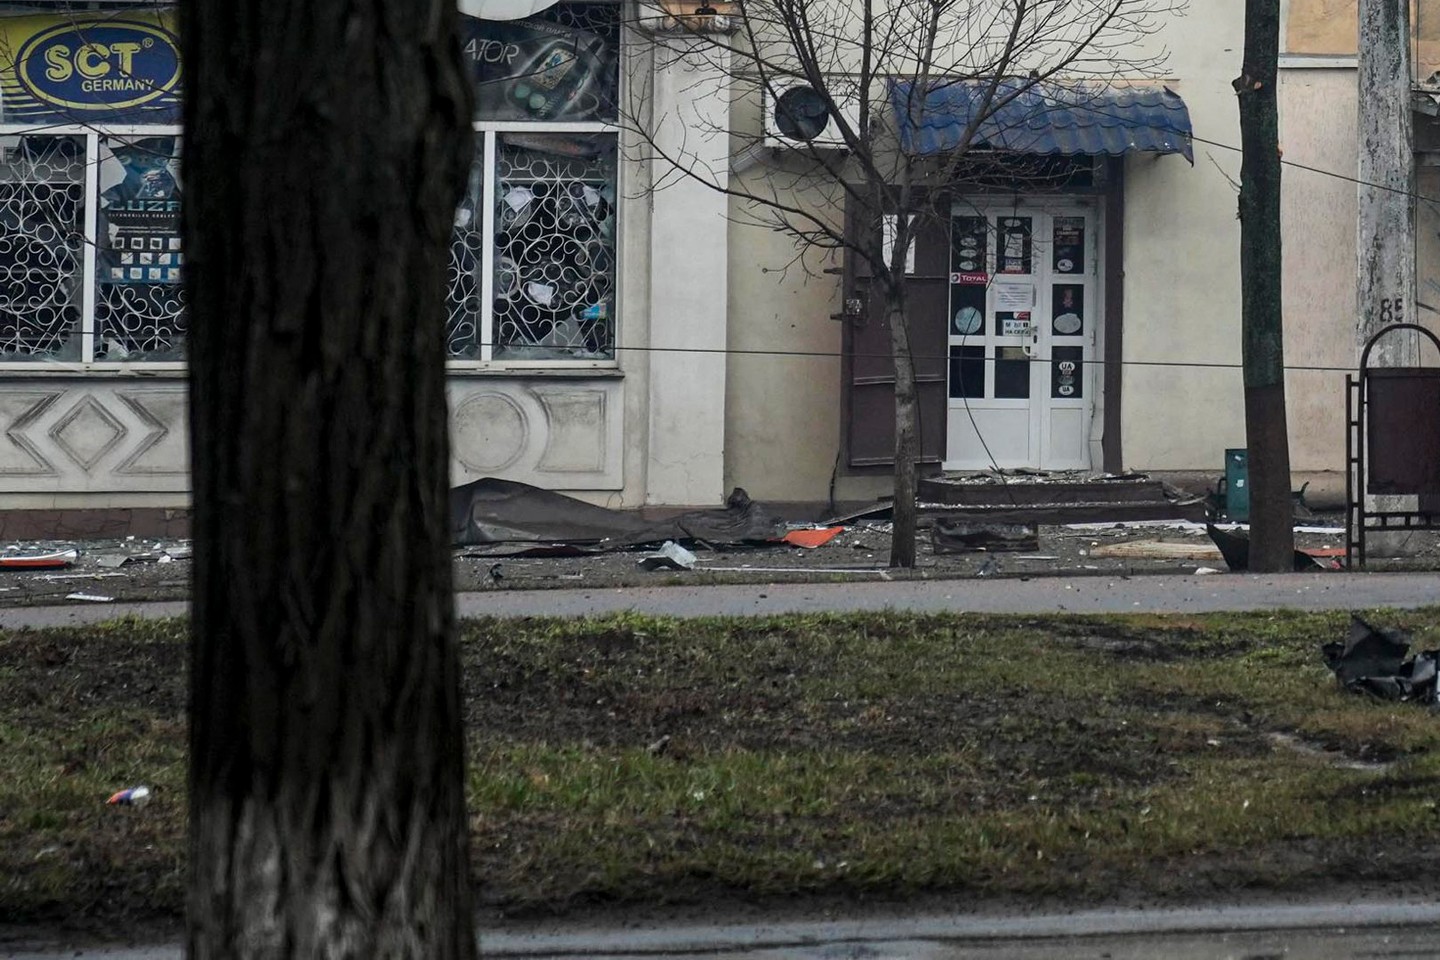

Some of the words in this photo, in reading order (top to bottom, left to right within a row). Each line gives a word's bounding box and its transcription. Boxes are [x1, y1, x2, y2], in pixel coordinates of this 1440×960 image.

[45, 43, 141, 82] SCT
[465, 38, 520, 65] ATOR
[82, 79, 155, 92] GERMANY
